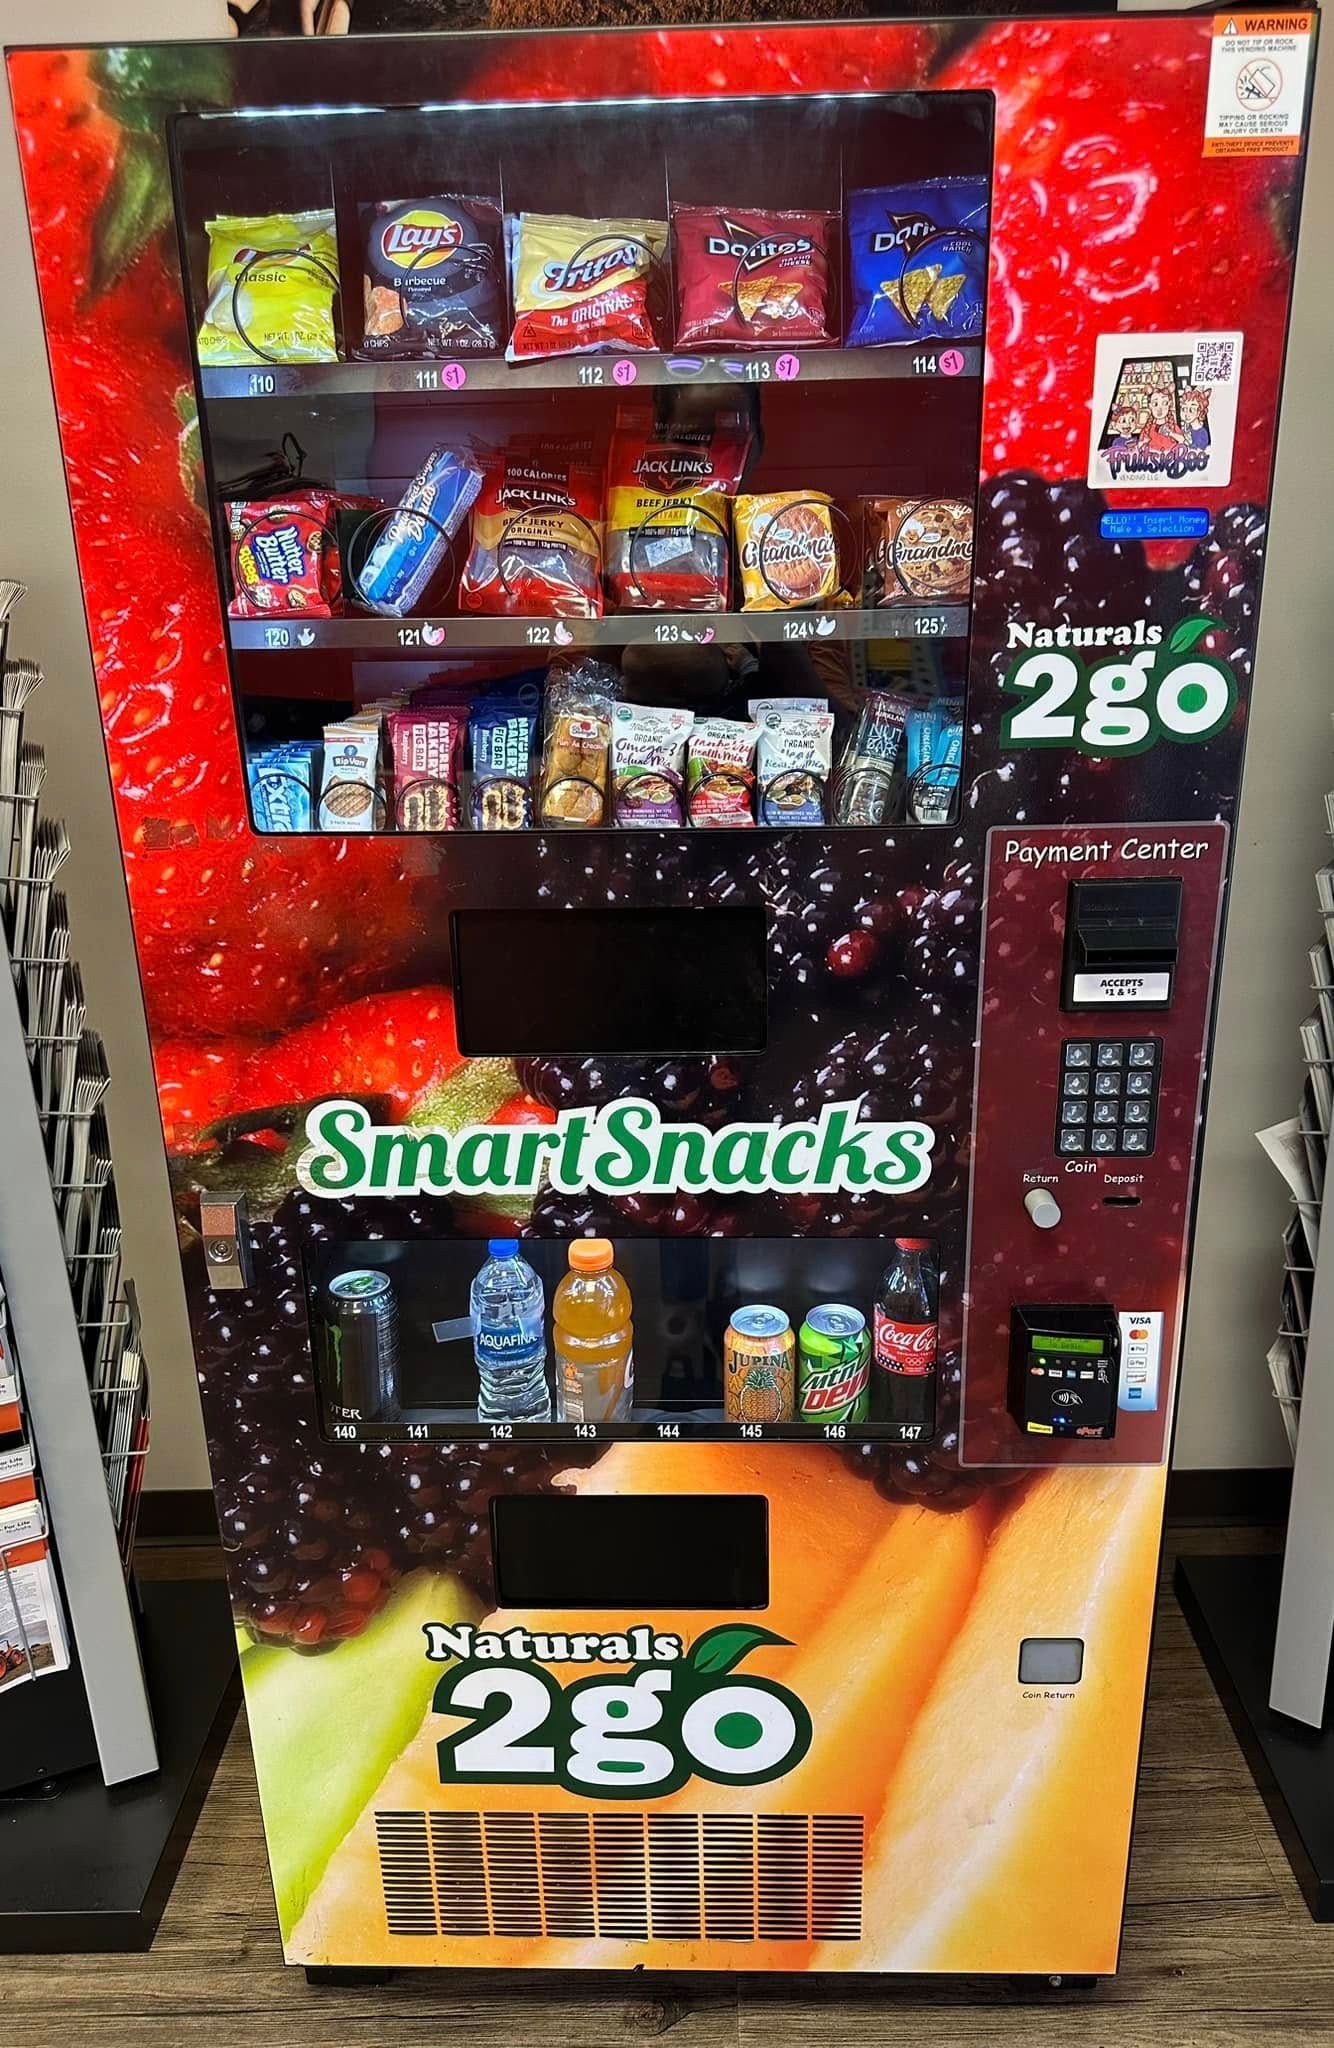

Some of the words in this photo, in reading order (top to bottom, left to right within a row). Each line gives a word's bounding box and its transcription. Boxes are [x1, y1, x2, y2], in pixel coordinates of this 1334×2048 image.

[1245, 18, 1308, 32] WARNING
[388, 223, 456, 253] Lay's
[709, 237, 811, 257] Doritos
[544, 245, 638, 292] Fritos
[551, 316, 568, 326] The
[572, 296, 634, 324] ORIGINAL
[779, 359, 793, 376] $1
[913, 356, 936, 373] 114
[944, 353, 958, 370] $1
[446, 368, 459, 384] $1
[579, 367, 603, 384] 112
[617, 364, 630, 382] $1
[746, 362, 770, 379] 113
[251, 375, 274, 393] 110
[416, 371, 438, 388] 111
[416, 451, 439, 487] Sugar
[507, 468, 522, 477] 100
[523, 468, 567, 482] CALORIES
[633, 460, 669, 474] JACK
[496, 489, 530, 503] JACK
[636, 499, 661, 507] BEEF
[529, 519, 564, 528] JERKY
[1144, 515, 1173, 524] Insert
[1179, 515, 1206, 524] Money
[511, 528, 553, 536] ORIGINAL
[1147, 525, 1195, 533] Selection
[256, 535, 290, 584] Butter
[275, 526, 304, 577] Nutter
[655, 625, 678, 642] 123
[783, 623, 807, 639] 124
[915, 618, 939, 634] 125
[1007, 620, 1163, 649] Naturals
[266, 628, 289, 646] 120
[398, 628, 420, 645] 121
[527, 627, 550, 644] 122
[1010, 650, 1229, 747] 2go
[913, 712, 936, 720] MINI
[415, 728, 424, 745] FIG
[494, 729, 504, 744] FIG
[634, 734, 663, 743] ORGANIC
[869, 723, 903, 742] NUT
[480, 730, 490, 762] Blueberry
[507, 719, 518, 777] BAKERY
[616, 738, 677, 759] Omega-3
[784, 739, 815, 749] ORGANIC
[866, 739, 899, 757] BARS
[335, 757, 350, 766] Rip
[350, 757, 365, 767] Van
[415, 748, 424, 767] BAR
[494, 746, 503, 766] BAR
[1005, 840, 1112, 869] Payment
[1121, 838, 1209, 860] Center
[1100, 978, 1144, 988] ACCEPTS
[1105, 988, 1116, 996] $1
[1117, 988, 1125, 996] &
[1127, 988, 1137, 996] $5
[304, 1100, 930, 1193] SmartSnacks
[1064, 1160, 1097, 1174] Coin
[1023, 1174, 1059, 1184] Return
[1104, 1174, 1144, 1185] Deposit
[1129, 1317, 1151, 1325] VISA
[480, 1332, 538, 1350] AQUAFINA
[334, 1426, 357, 1439] 140
[407, 1425, 429, 1439] 141
[490, 1425, 513, 1439] 142
[574, 1425, 597, 1438] 143
[657, 1425, 680, 1438] 144
[739, 1425, 763, 1438] 145
[823, 1425, 846, 1439] 146
[899, 1426, 922, 1439] 147
[426, 1626, 680, 1661] Naturals
[1022, 1691, 1042, 1699] Coin
[1044, 1691, 1076, 1699] Return
[450, 1667, 796, 1786] 2go
